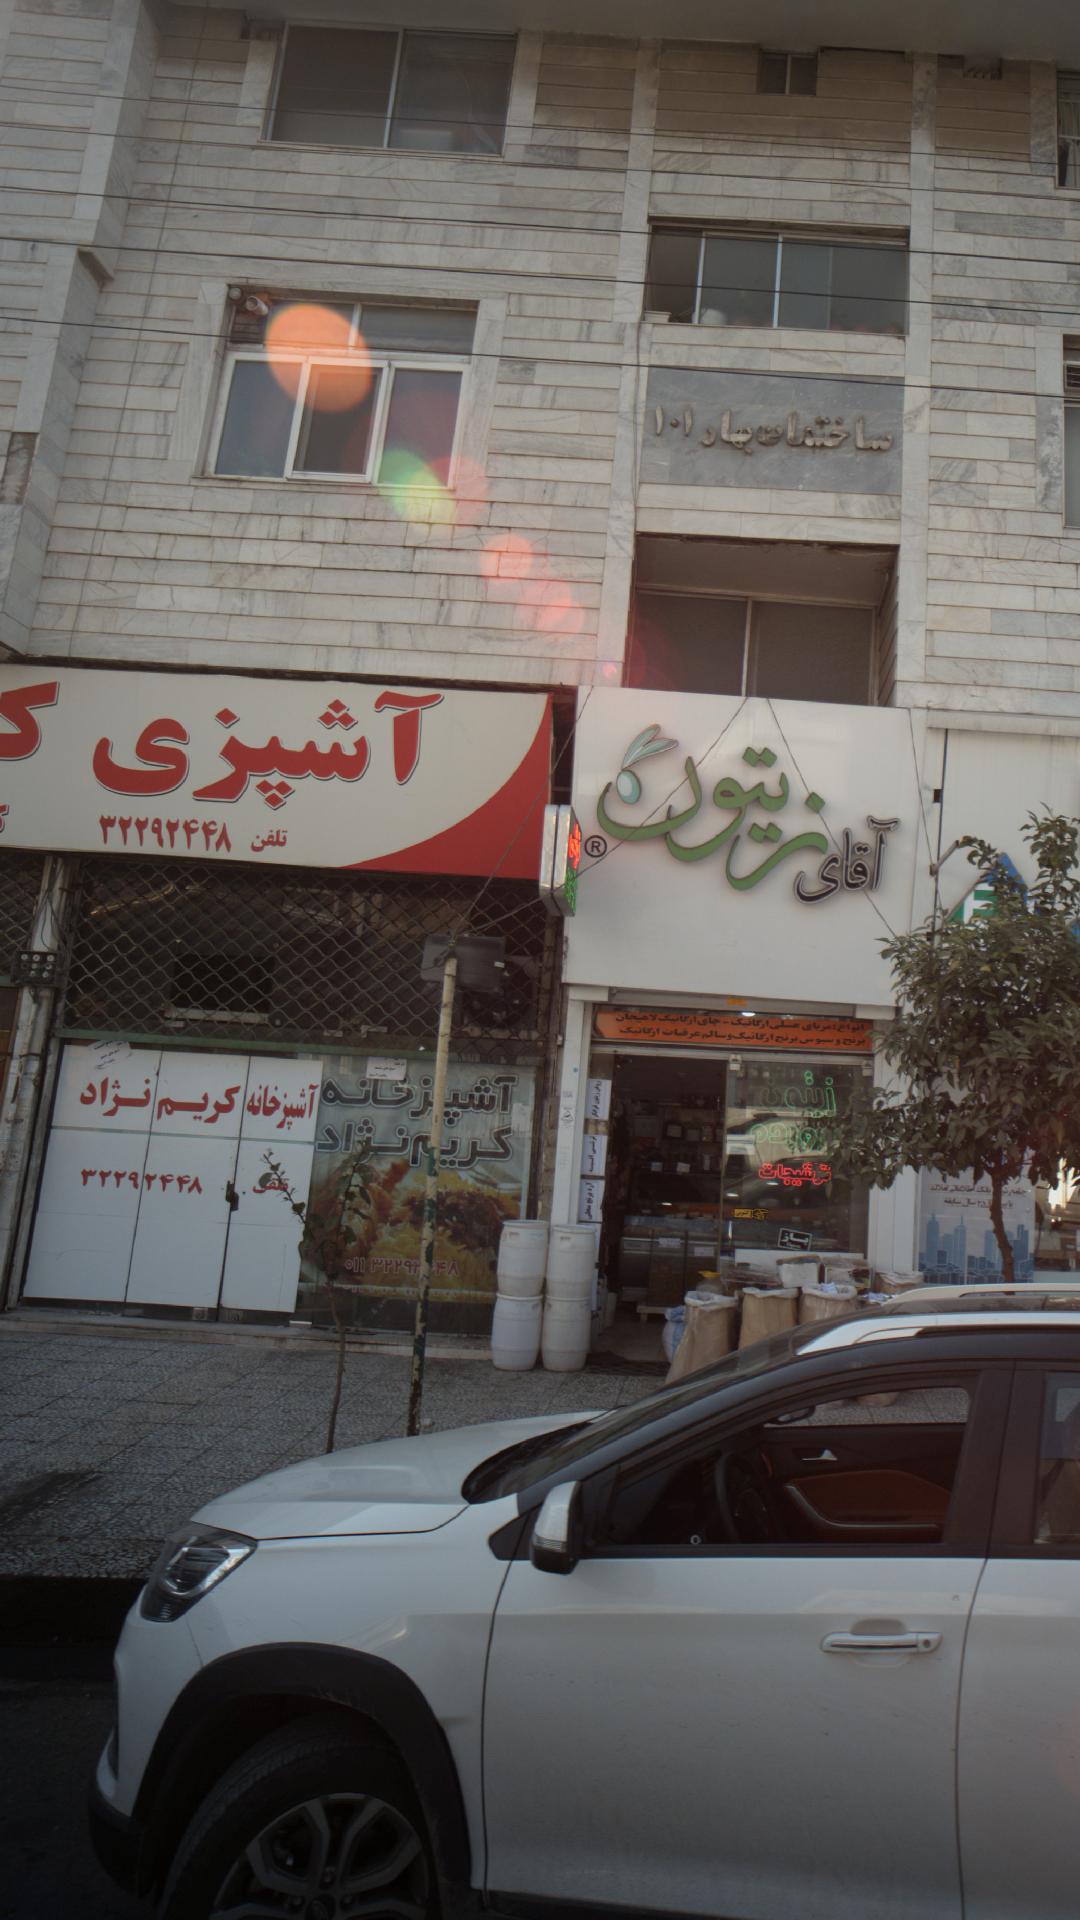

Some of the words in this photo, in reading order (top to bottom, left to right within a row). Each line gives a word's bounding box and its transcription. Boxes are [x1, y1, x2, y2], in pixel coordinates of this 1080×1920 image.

[92, 690, 445, 811] آشپزی
[99, 815, 232, 853] ۳۲۲۹۲۴۴۸
[596, 746, 829, 891] زیتون
[250, 828, 288, 853] تلفن
[792, 815, 901, 904] آقای
[79, 1076, 151, 1117] نژاد
[156, 1085, 241, 1124] کریم
[247, 1084, 319, 1131] آشپزخانه
[80, 1168, 203, 1195] ۳۲۲۹۲۴۴۸
